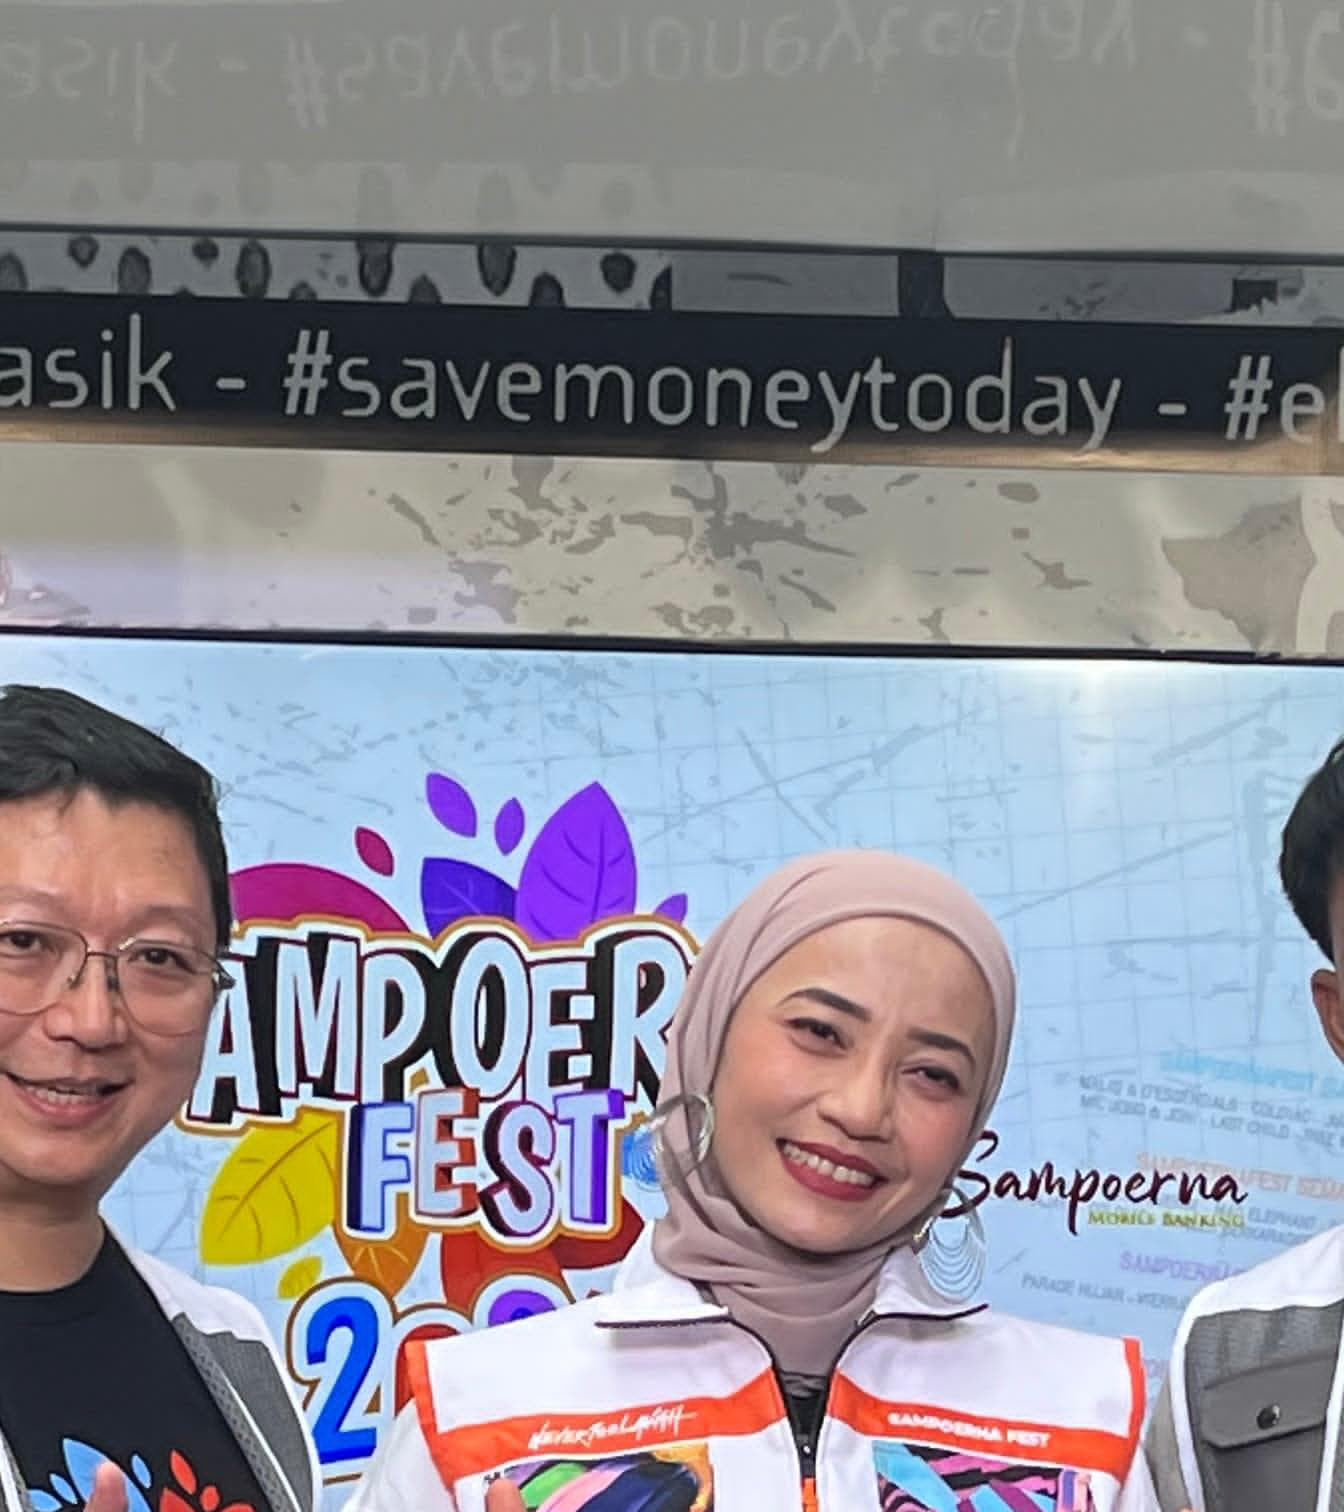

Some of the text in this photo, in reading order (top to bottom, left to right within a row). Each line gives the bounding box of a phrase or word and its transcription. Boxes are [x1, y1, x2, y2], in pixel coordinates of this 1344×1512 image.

[283, 329, 1122, 454] #savemoneytoday
[348, 1088, 626, 1237] FEST
[940, 1130, 1249, 1237] Sampoerna
[1006, 1428, 1052, 1449] FEST
